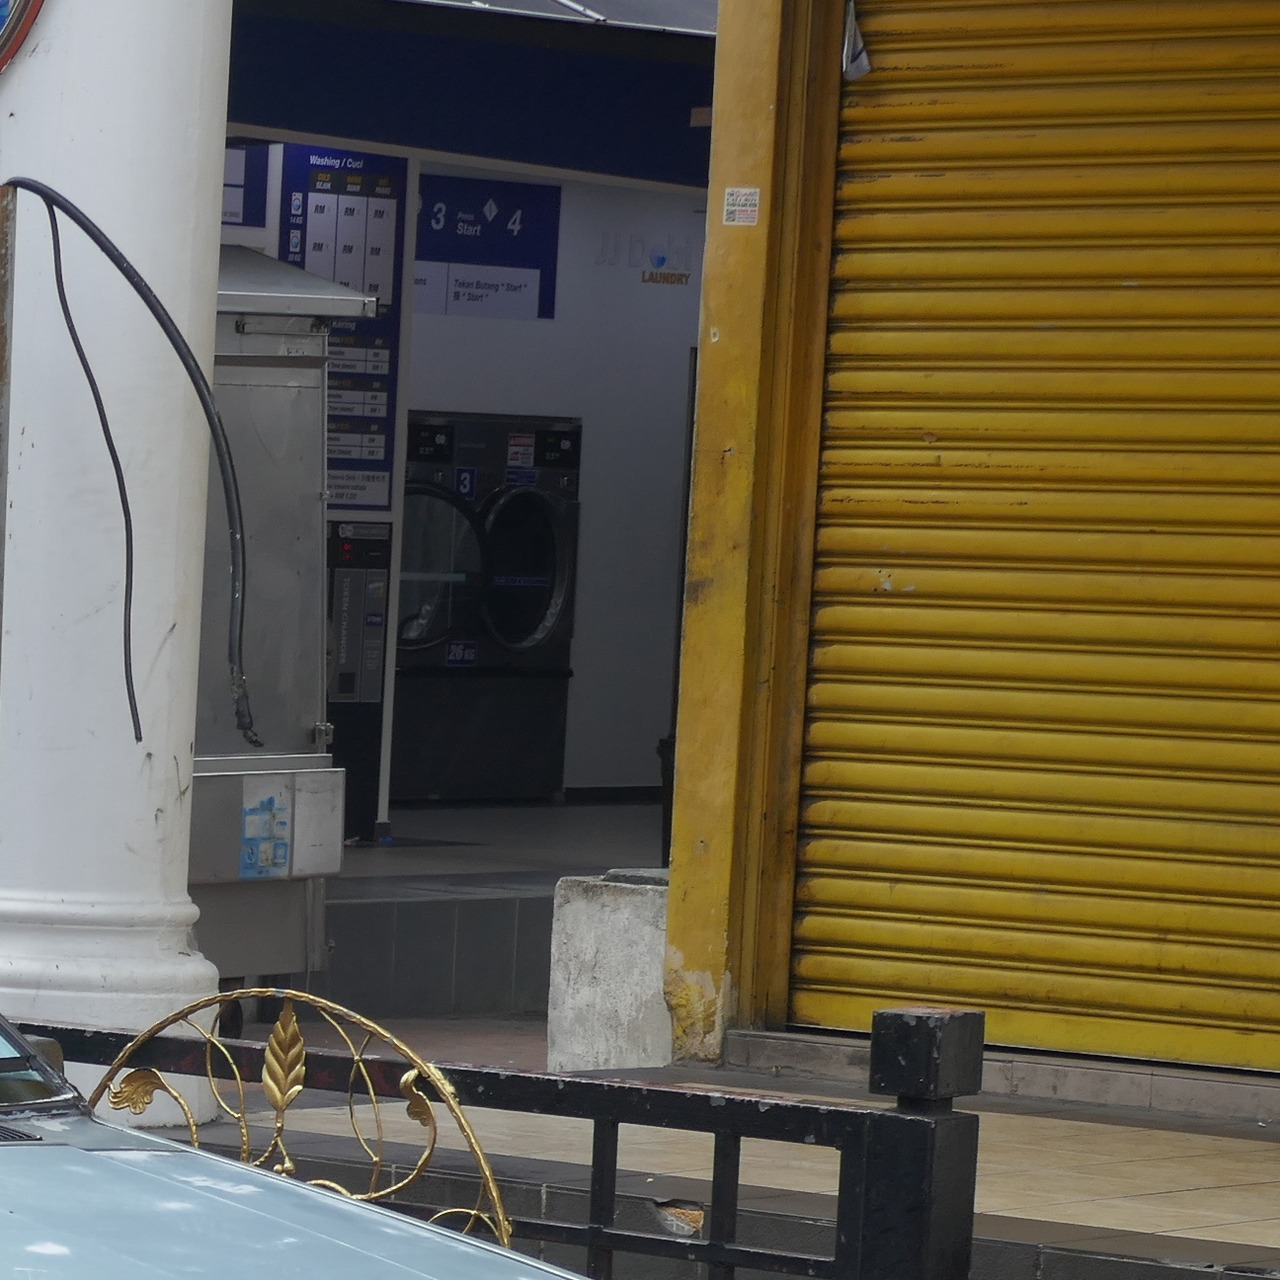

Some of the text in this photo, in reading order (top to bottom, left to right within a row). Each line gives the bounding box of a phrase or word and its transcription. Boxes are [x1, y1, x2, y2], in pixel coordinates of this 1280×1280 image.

[309, 155, 340, 169] Washing
[431, 202, 447, 231] 3
[506, 209, 523, 237] 4
[456, 222, 482, 237] Start
[641, 270, 691, 285] LAUNDRY
[460, 472, 471, 494] 3
